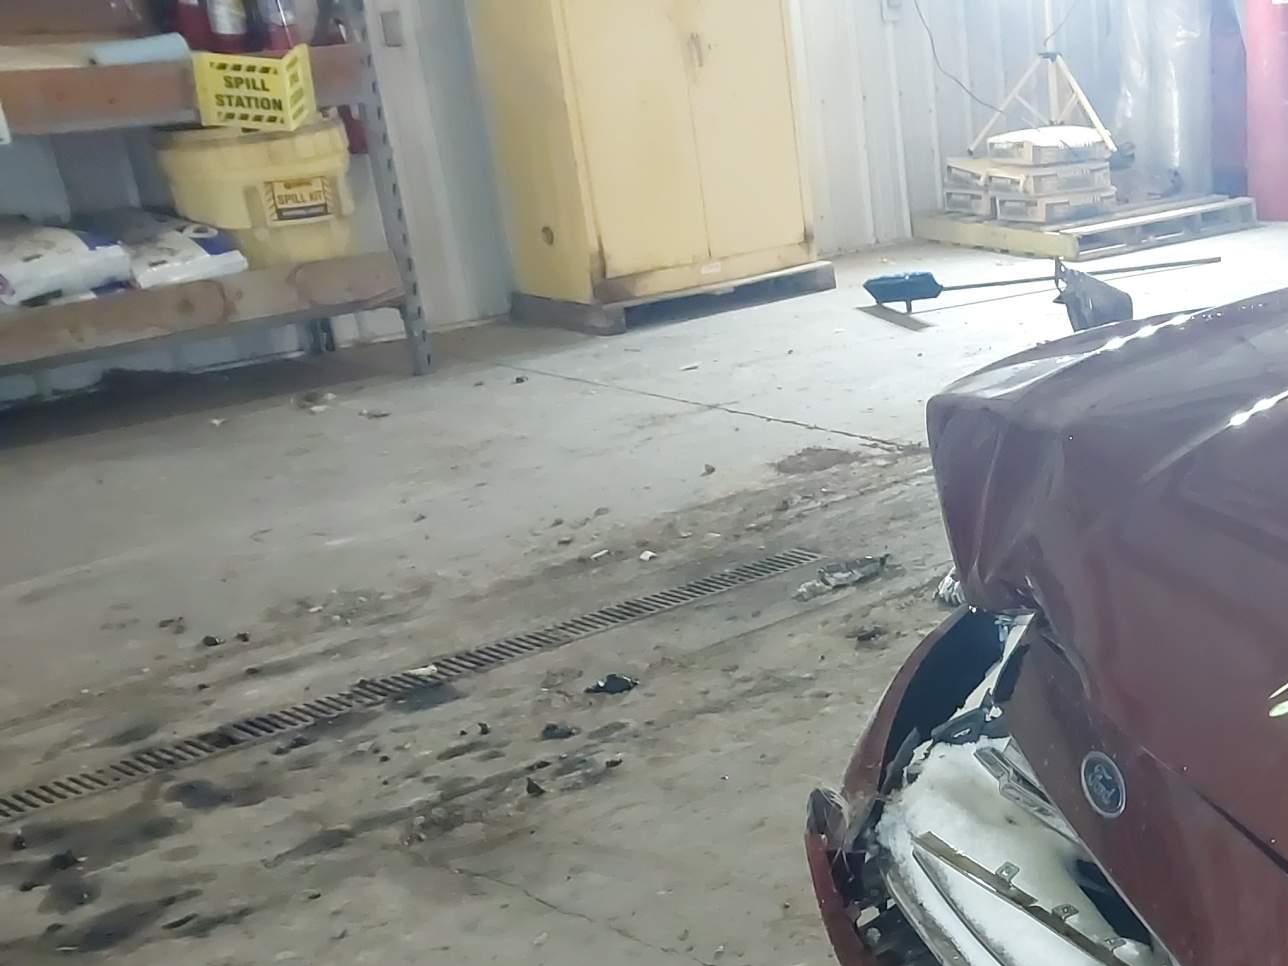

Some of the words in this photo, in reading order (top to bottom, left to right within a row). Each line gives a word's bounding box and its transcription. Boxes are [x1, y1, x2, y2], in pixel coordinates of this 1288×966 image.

[223, 75, 270, 92] SPILL
[214, 94, 283, 112] STATION
[277, 192, 305, 205] SPILL
